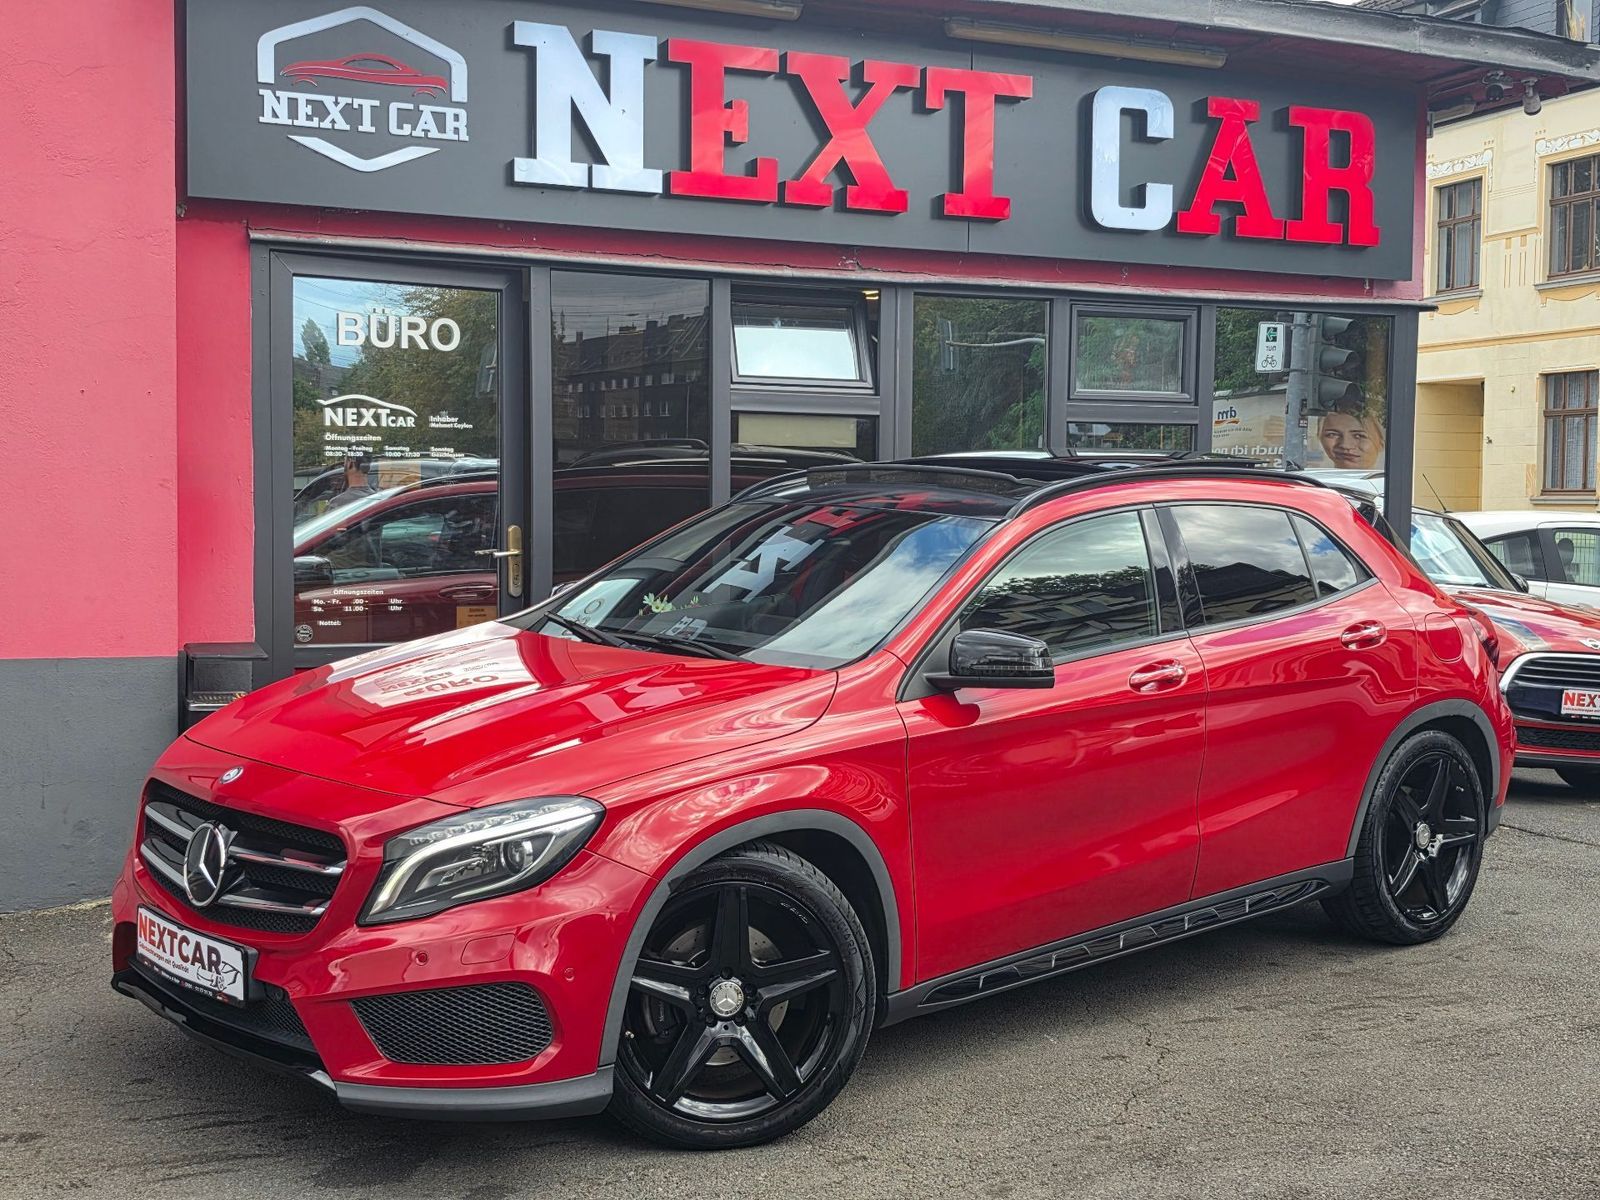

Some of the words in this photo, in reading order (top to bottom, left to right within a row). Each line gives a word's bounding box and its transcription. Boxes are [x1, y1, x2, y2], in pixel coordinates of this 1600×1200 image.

[257, 88, 380, 133] NEXT
[388, 102, 470, 142] CAR
[512, 20, 1033, 219] NEXT
[1091, 85, 1381, 247] CAR
[336, 307, 461, 352] BÜRO
[325, 432, 381, 442] Öffnungszeiten
[1564, 692, 1600, 708] NEX
[138, 911, 222, 976] NEXTCAR
